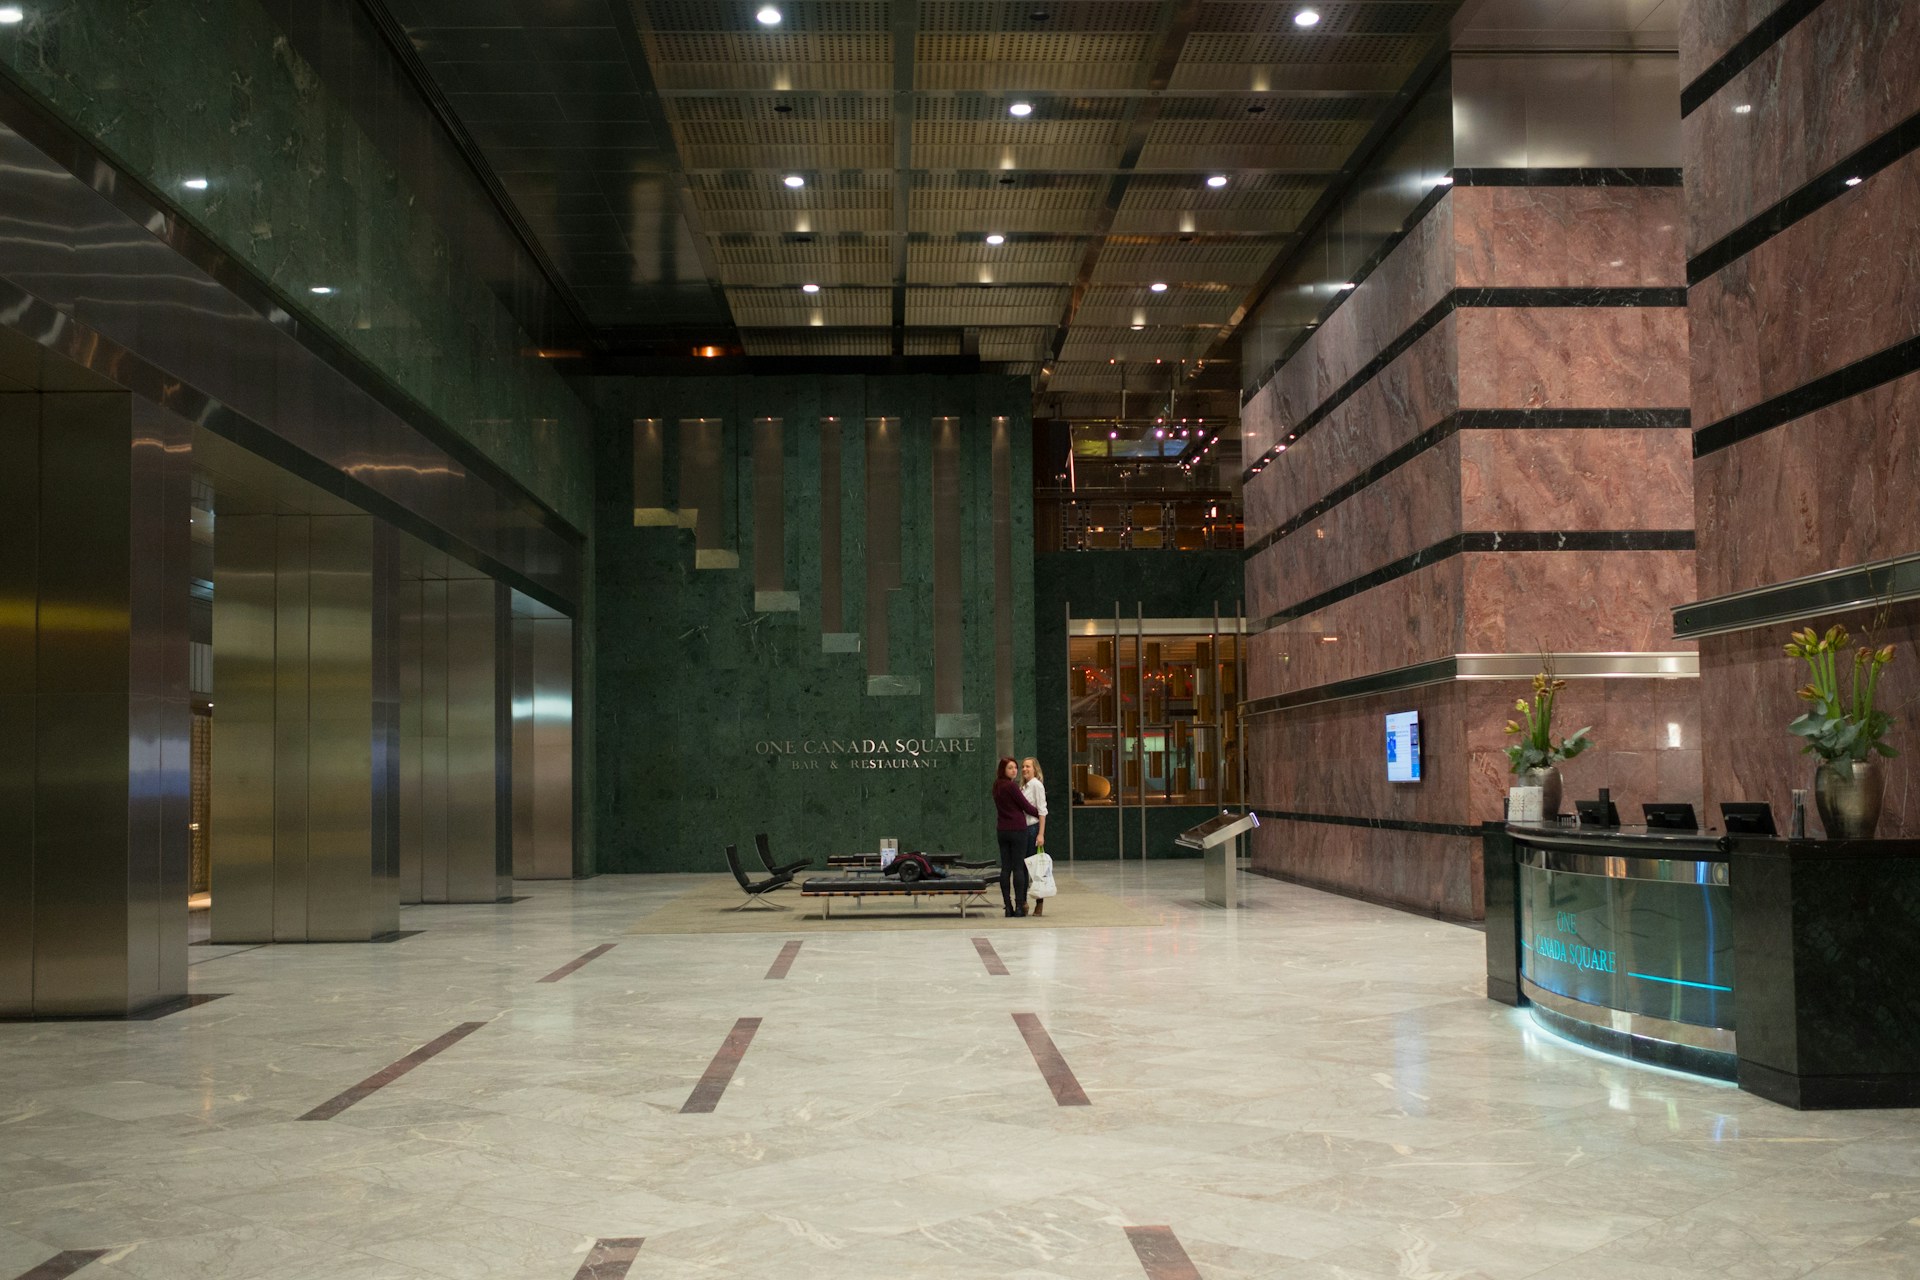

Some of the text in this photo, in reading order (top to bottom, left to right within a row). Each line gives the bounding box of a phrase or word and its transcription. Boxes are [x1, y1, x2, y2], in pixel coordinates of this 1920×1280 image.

[755, 738, 976, 756] ONE CANADA SQUARE
[791, 759, 939, 769] BAR & RESTAURANT
[1557, 911, 1577, 934] ONE
[1536, 935, 1616, 972] CANADA SQUARE
